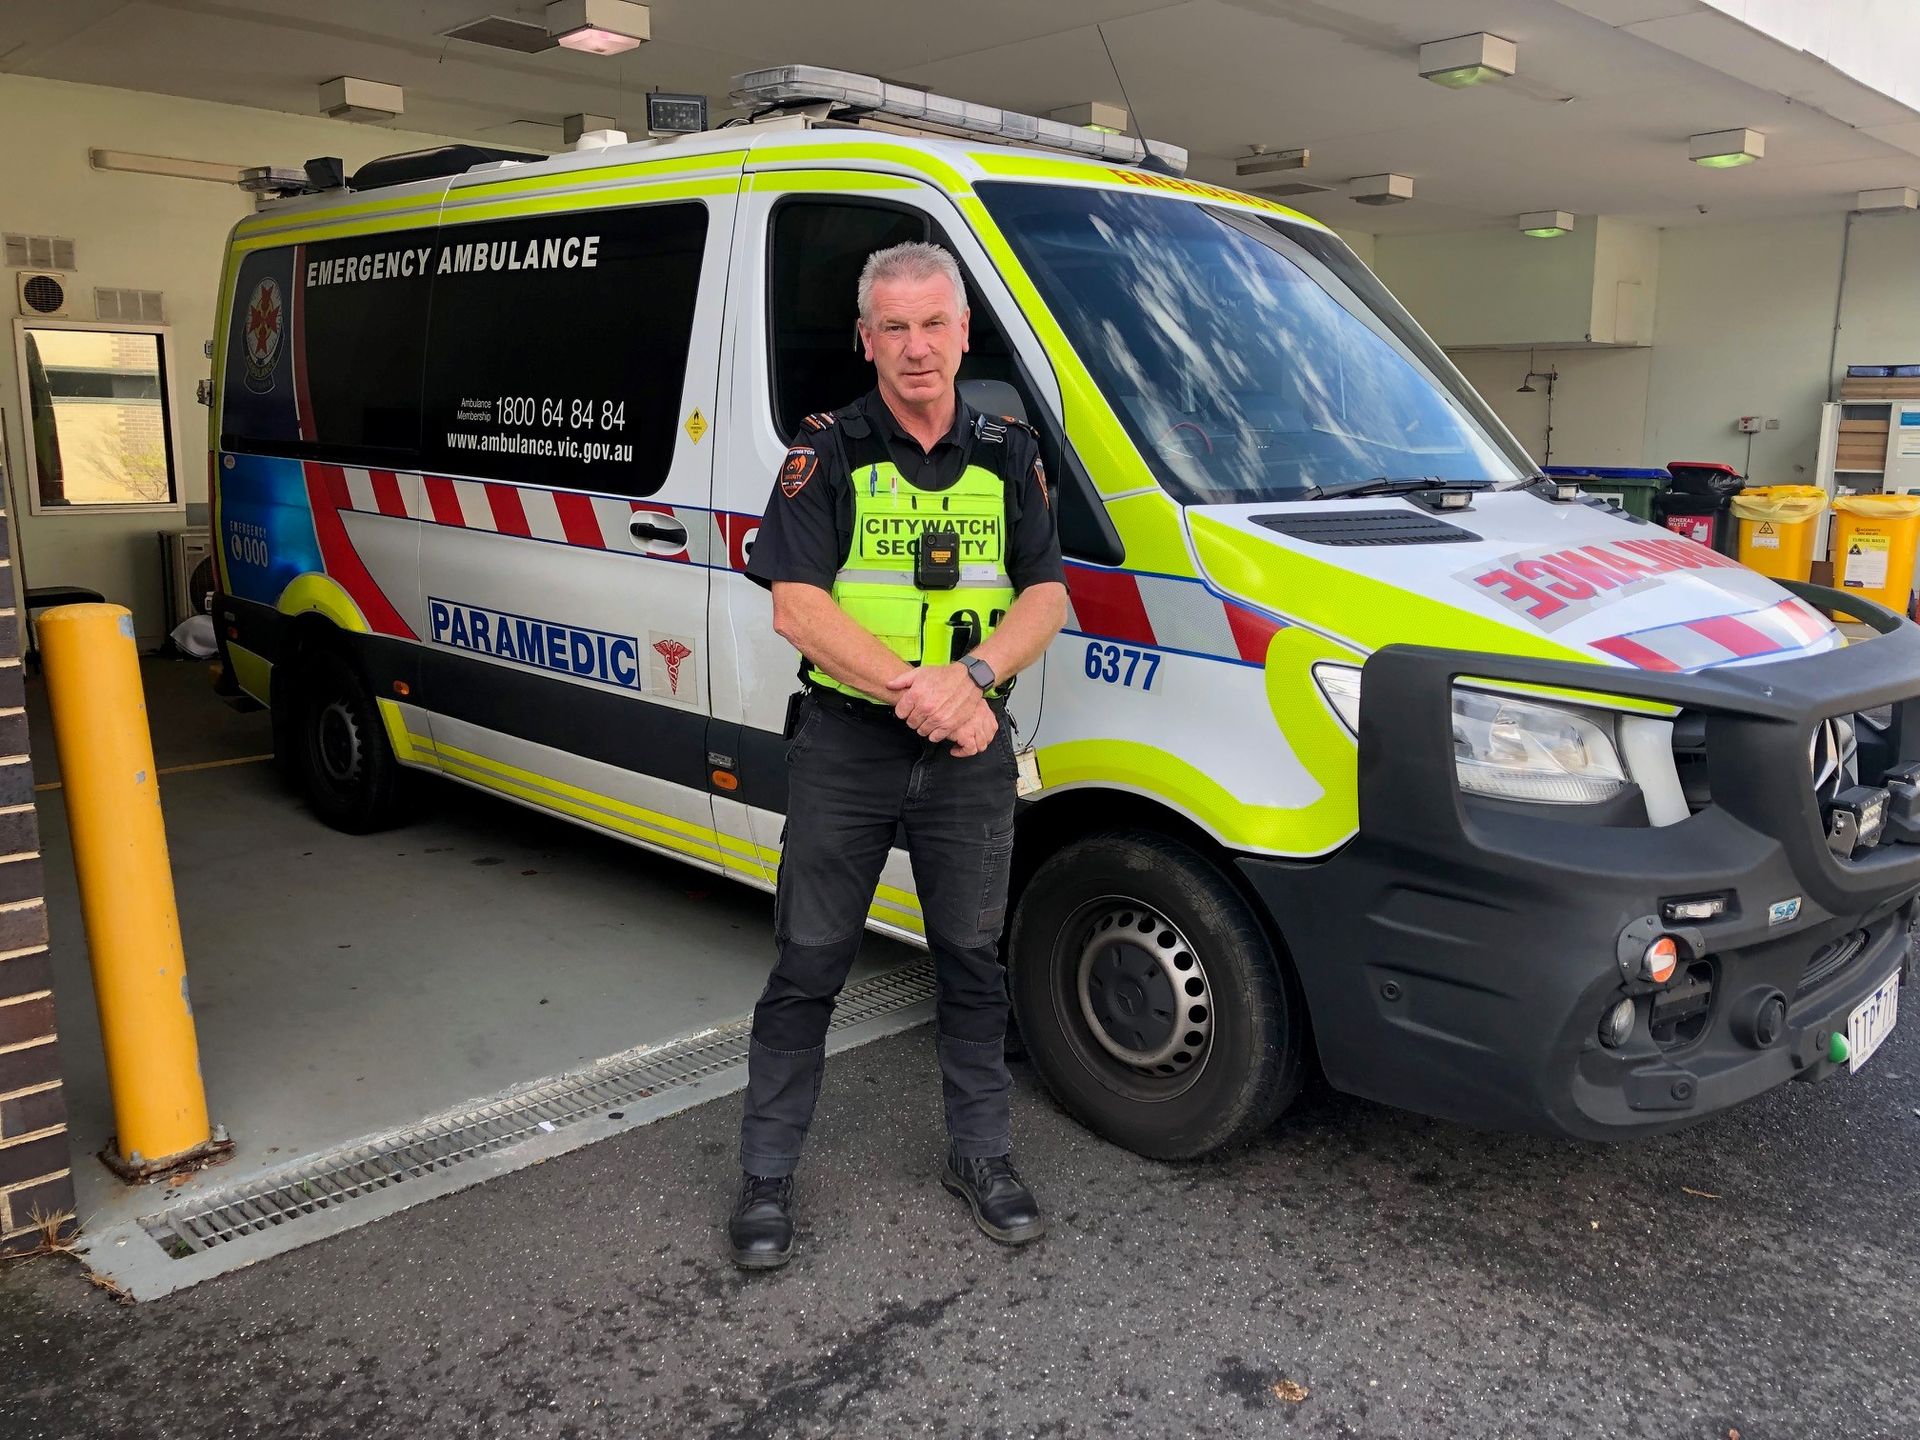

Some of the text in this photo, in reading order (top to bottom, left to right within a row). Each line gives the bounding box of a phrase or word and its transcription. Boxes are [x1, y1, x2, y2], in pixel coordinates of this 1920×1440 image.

[306, 236, 600, 288] EMERGENCY AMBULANCE
[457, 410, 492, 422] Membership
[461, 396, 626, 431] Ambulance 1800 64 84 84
[447, 432, 633, 464] www.ambulance.vic.gov.au
[229, 520, 267, 539] EMERGENCY
[865, 518, 996, 535] CITYWATCH
[243, 536, 268, 568] 000
[876, 539, 988, 556] SECTY
[431, 602, 636, 685] PARAMEDIC
[1085, 641, 1161, 691] 6377
